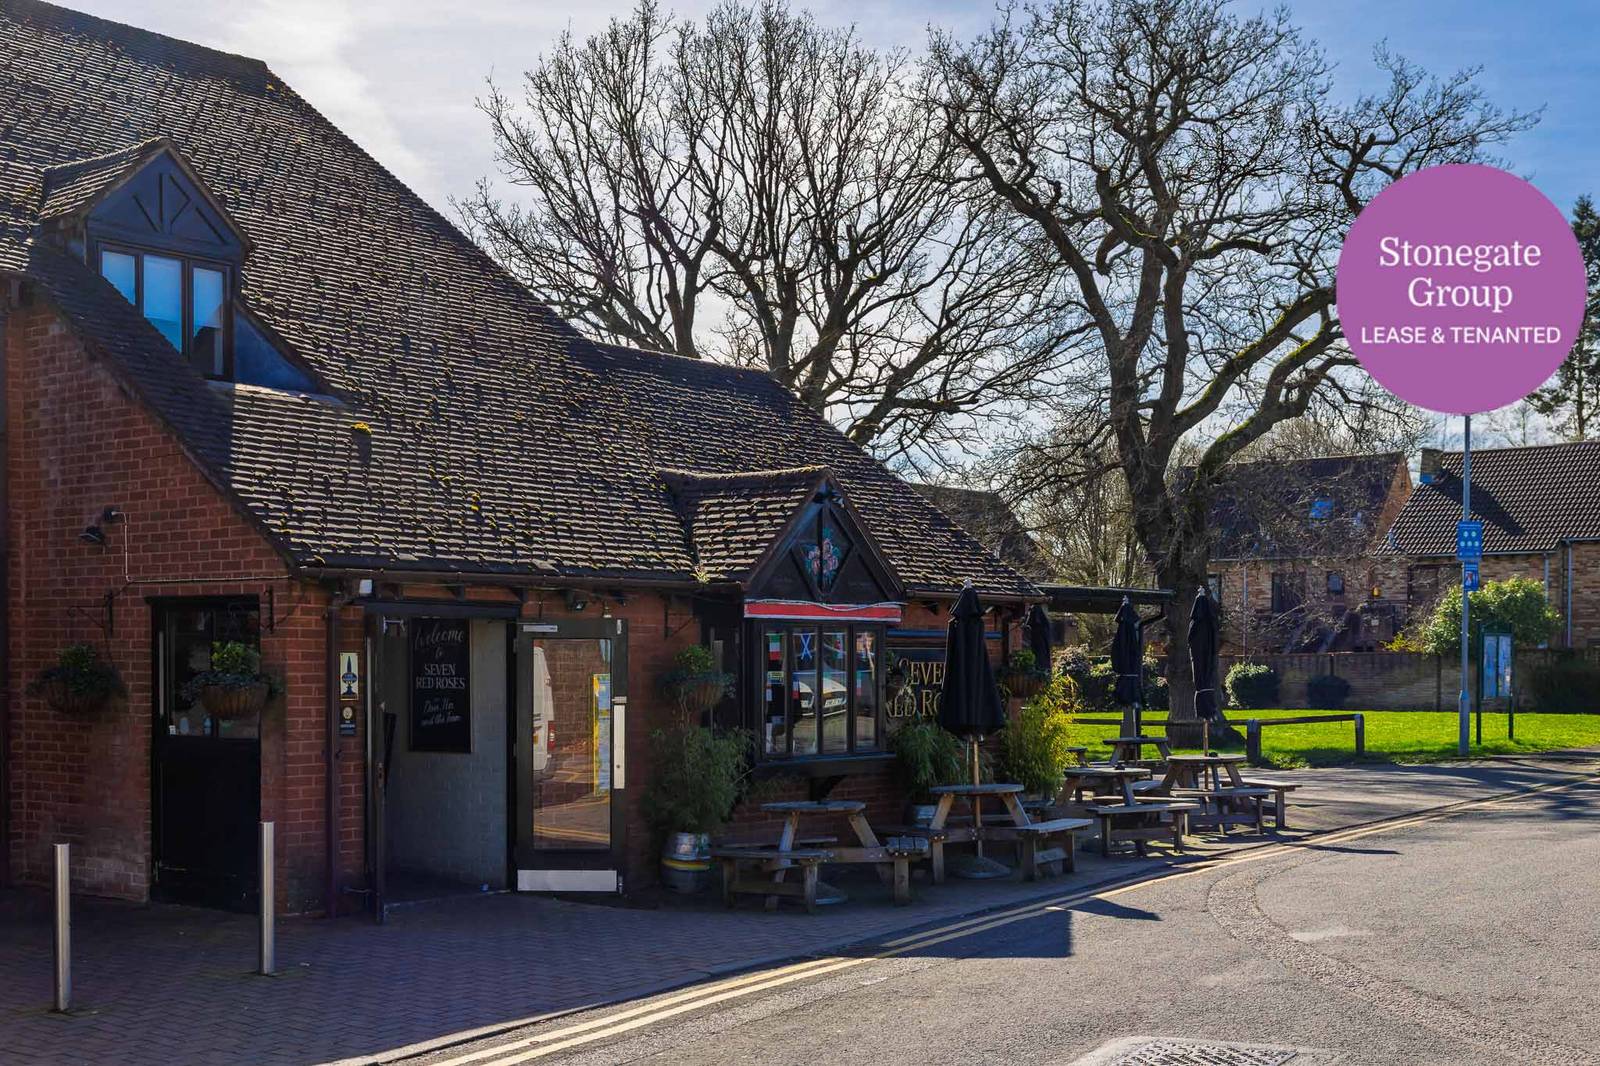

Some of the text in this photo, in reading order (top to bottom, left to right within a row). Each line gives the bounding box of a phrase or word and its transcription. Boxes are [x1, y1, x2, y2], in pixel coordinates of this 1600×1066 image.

[424, 663, 456, 676] SEVEN
[415, 676, 466, 689] RED ROSES
